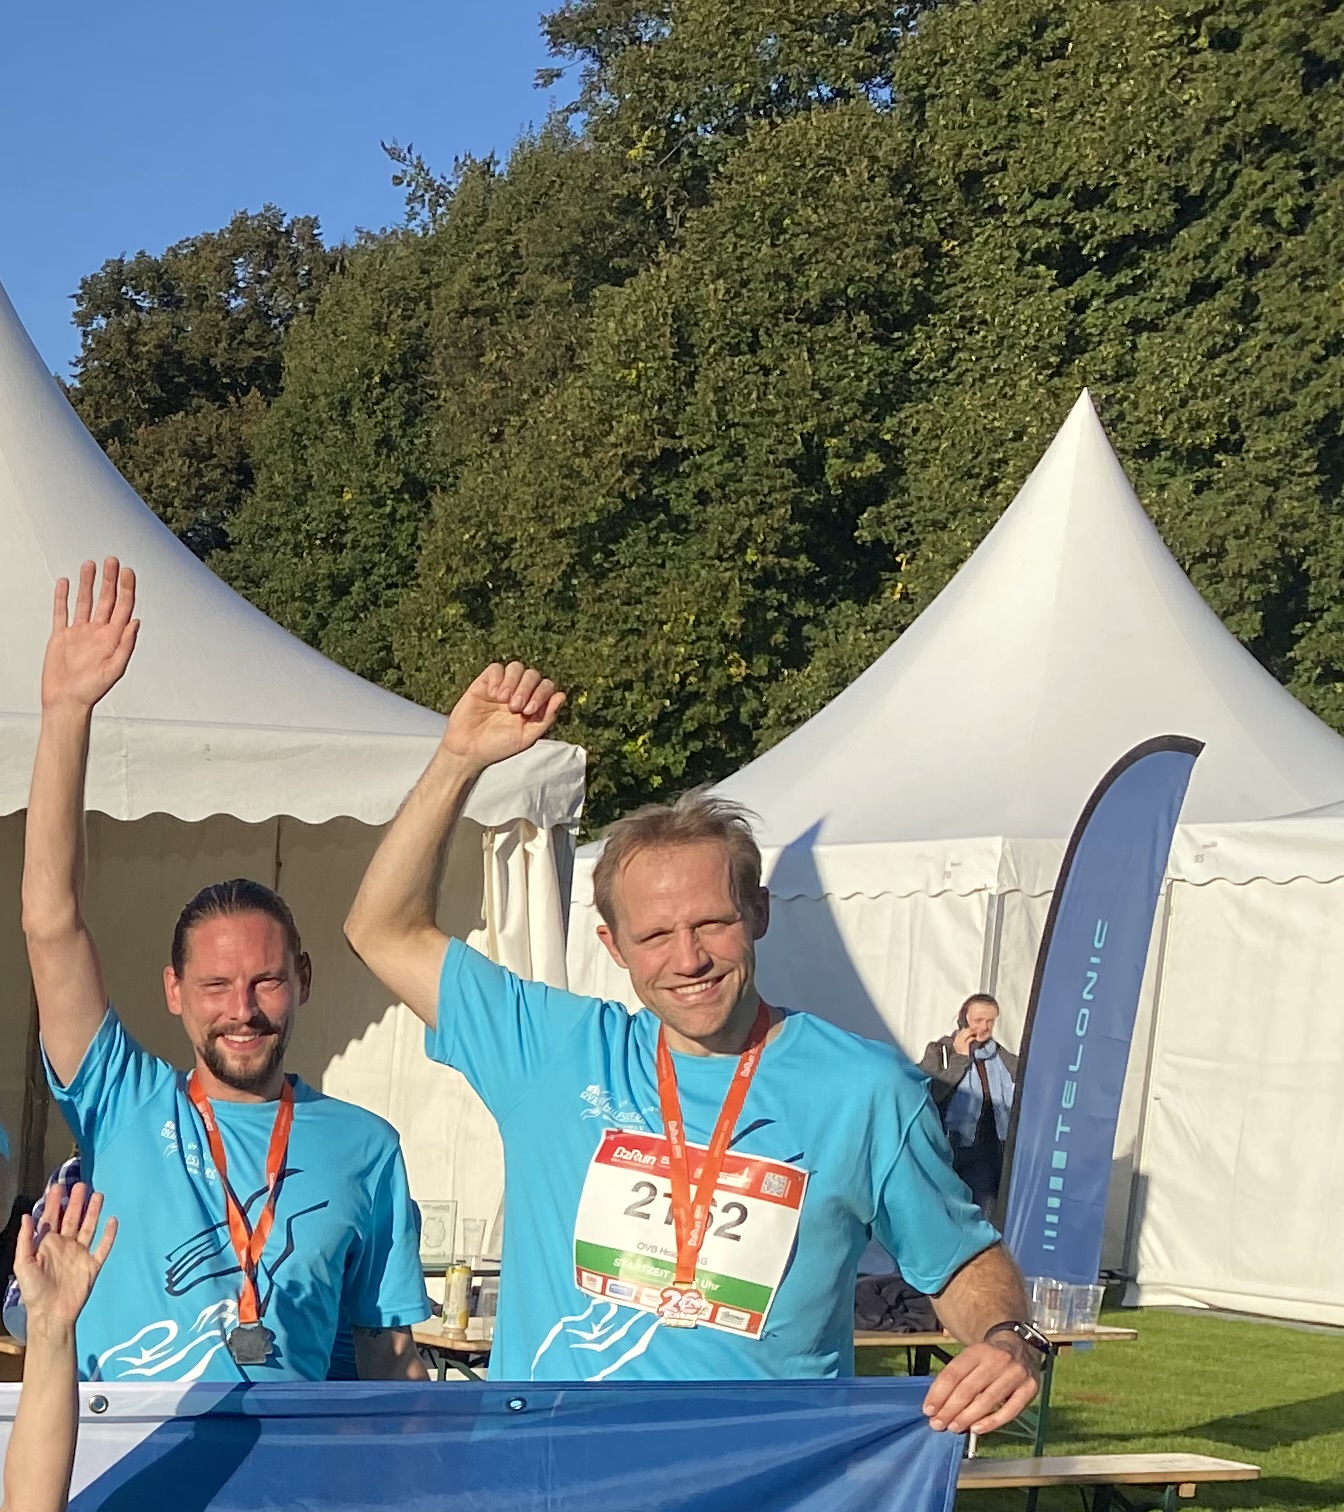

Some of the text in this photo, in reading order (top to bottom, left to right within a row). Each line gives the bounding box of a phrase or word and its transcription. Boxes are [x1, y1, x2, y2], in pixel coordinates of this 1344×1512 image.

[1055, 918, 1109, 1141] TELONIC
[636, 1241, 658, 1253] OVB
[612, 1255, 721, 1291] STARTZEIT Uhr
